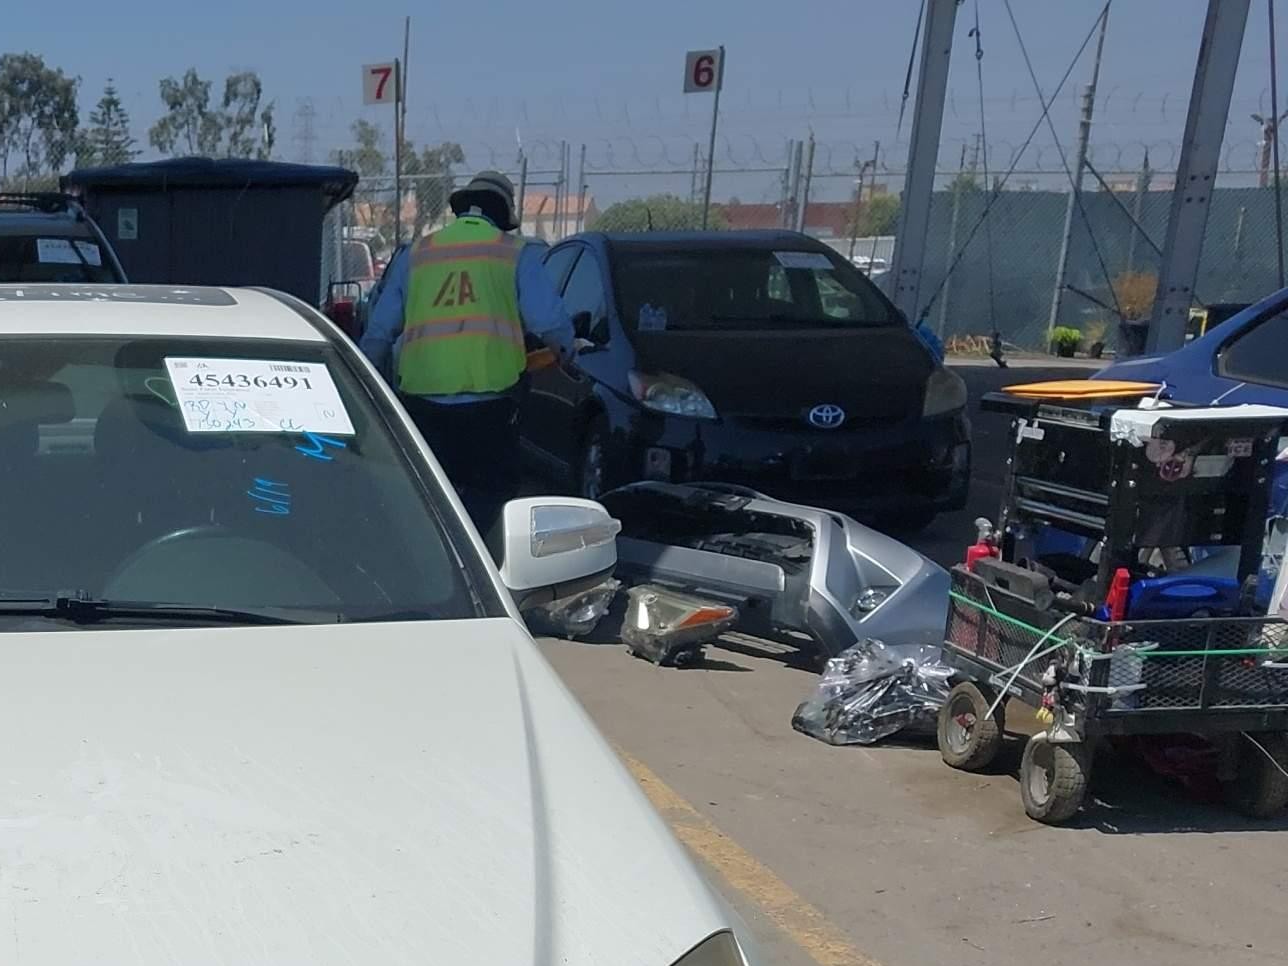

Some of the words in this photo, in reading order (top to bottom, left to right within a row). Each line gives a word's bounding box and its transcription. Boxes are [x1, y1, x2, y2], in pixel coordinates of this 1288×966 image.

[371, 67, 392, 99] 7
[694, 55, 714, 87] 6
[189, 373, 312, 390] 45436491
